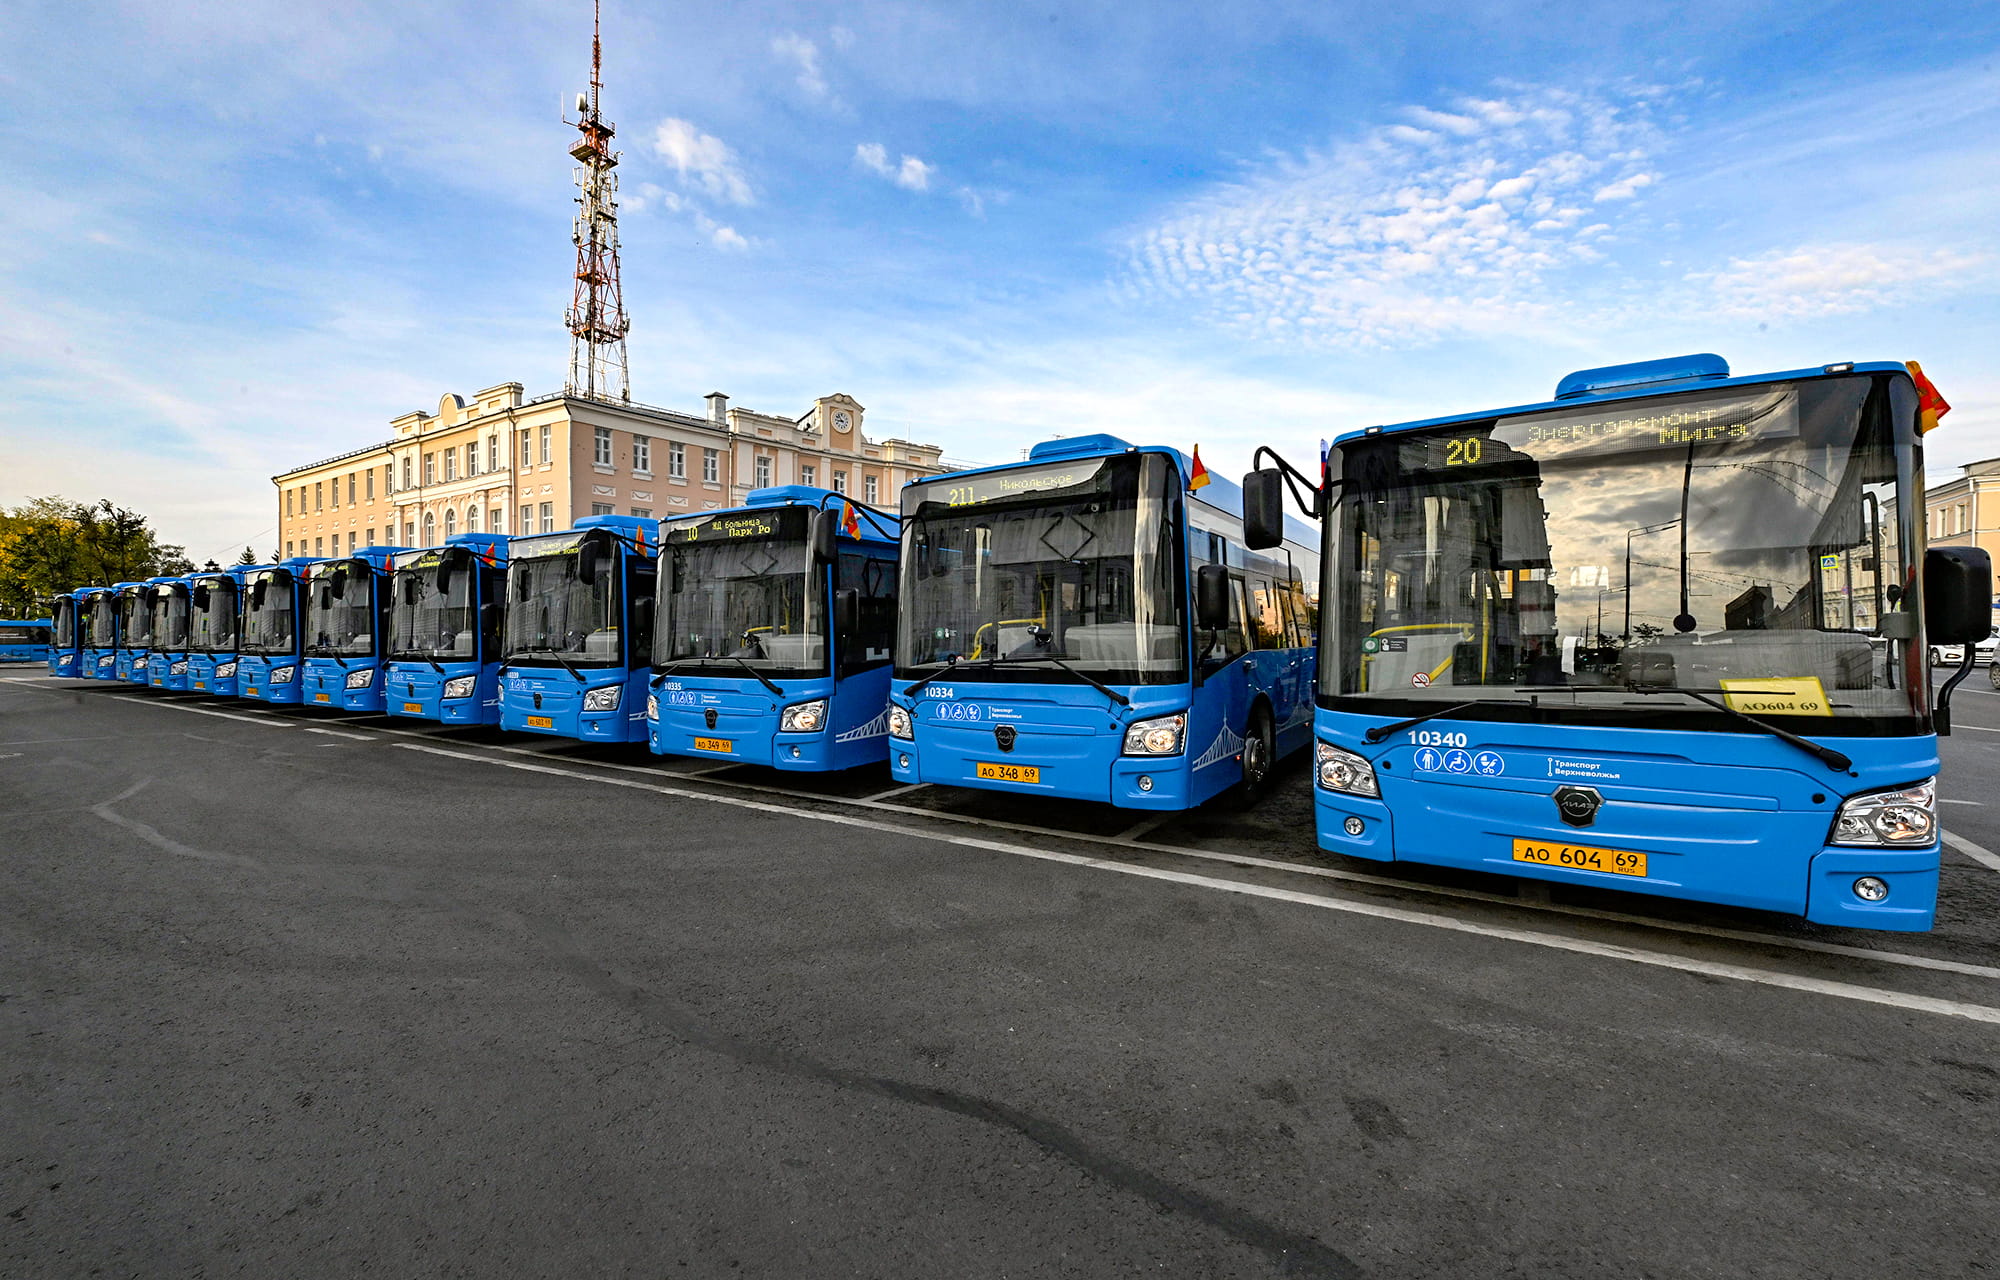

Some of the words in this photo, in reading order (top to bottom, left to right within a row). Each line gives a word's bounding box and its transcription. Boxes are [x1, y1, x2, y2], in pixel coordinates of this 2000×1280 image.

[1528, 409, 1718, 442] Энергоремонт
[1446, 437, 1481, 466] 20
[1000, 474, 1073, 491] Никольское
[950, 487, 976, 507] 211
[725, 519, 761, 529] больница
[687, 526, 698, 541] 10
[664, 682, 682, 690] 10335
[924, 687, 954, 698] 10334
[1800, 702, 1818, 711] 69
[708, 740, 720, 750] 349
[1408, 730, 1467, 748] 10340
[1555, 759, 1601, 771] Транспорт
[999, 766, 1019, 780] 348
[1024, 768, 1035, 778] 69
[1555, 768, 1620, 779] Верхневолжья
[1560, 847, 1601, 868] 604
[1615, 853, 1638, 868] 69
